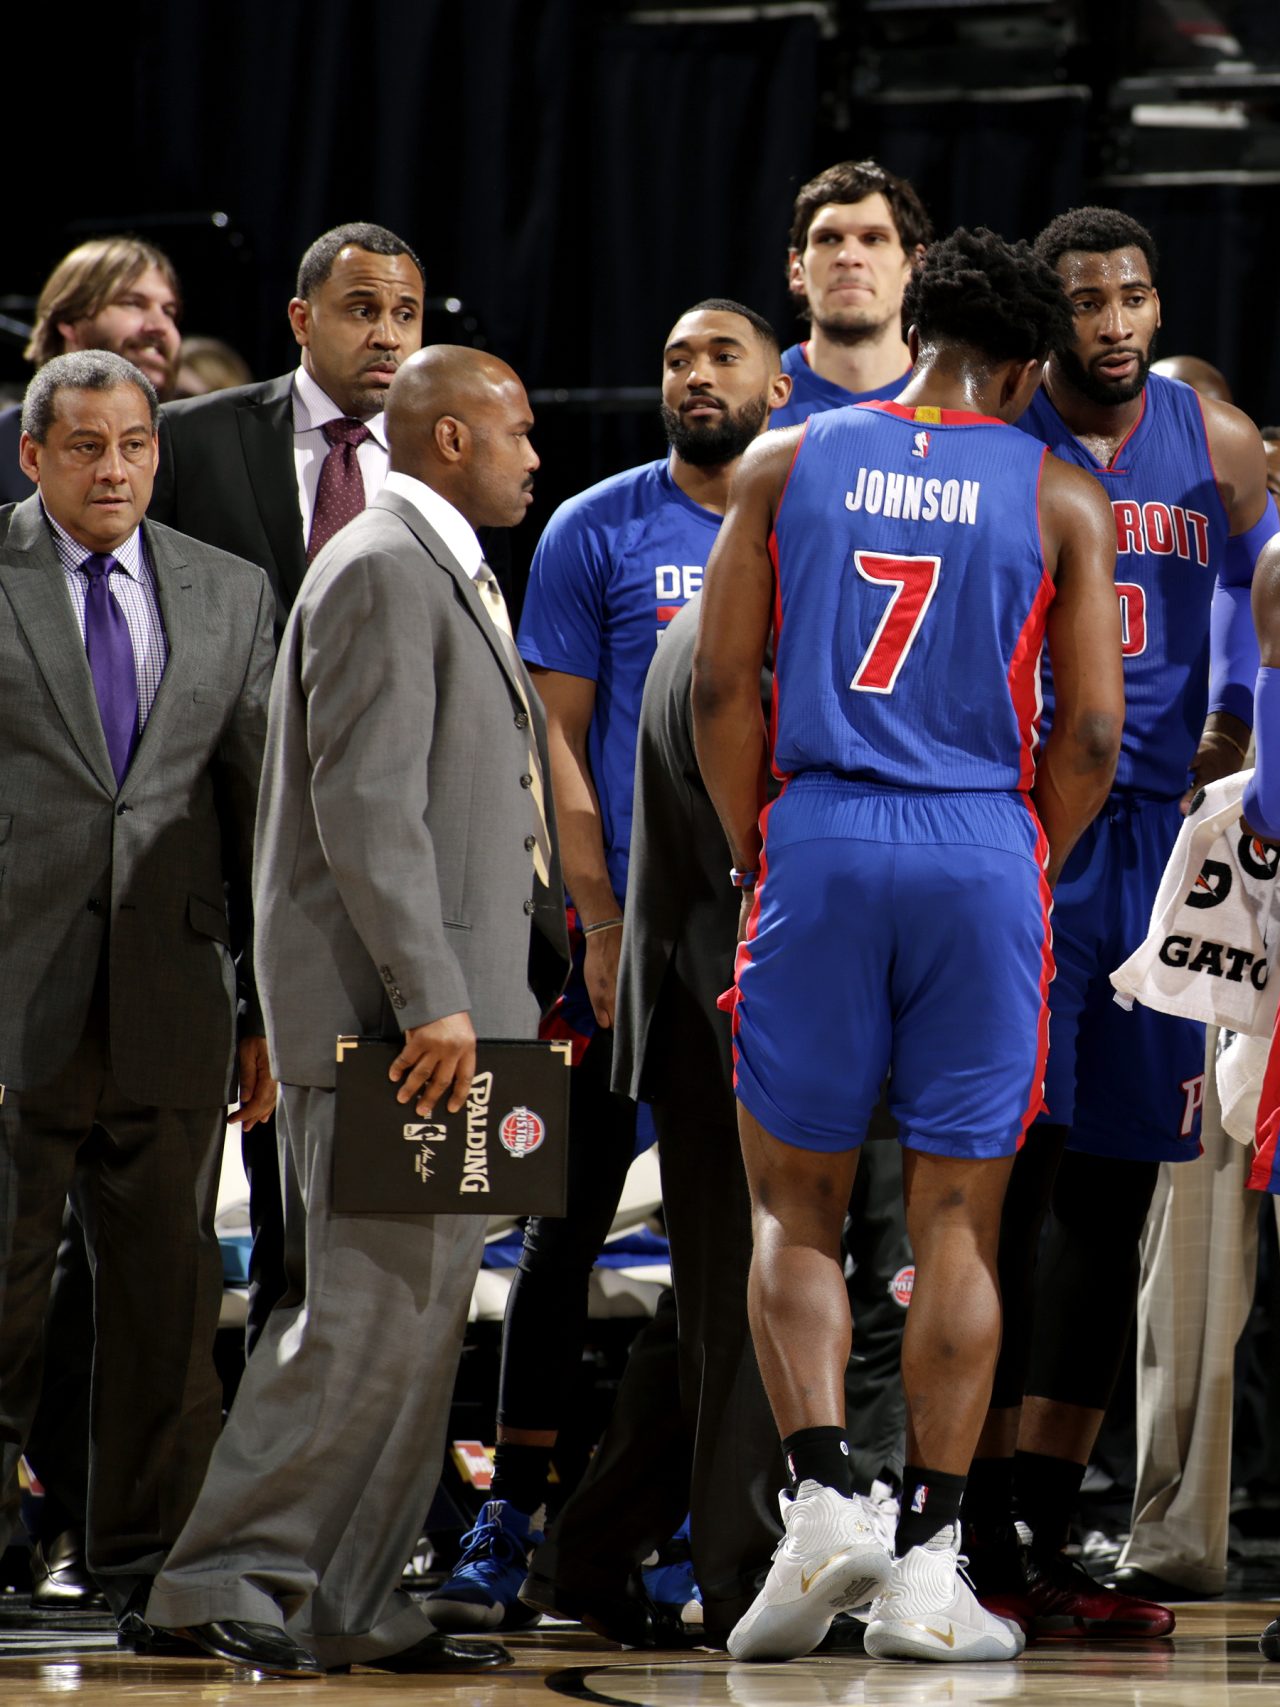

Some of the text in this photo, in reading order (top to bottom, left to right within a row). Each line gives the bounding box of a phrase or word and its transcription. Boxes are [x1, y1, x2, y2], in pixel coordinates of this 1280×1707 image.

[844, 467, 980, 525] JOHNSON
[850, 550, 942, 695] 7
[510, 1105, 528, 1159] PISTONS
